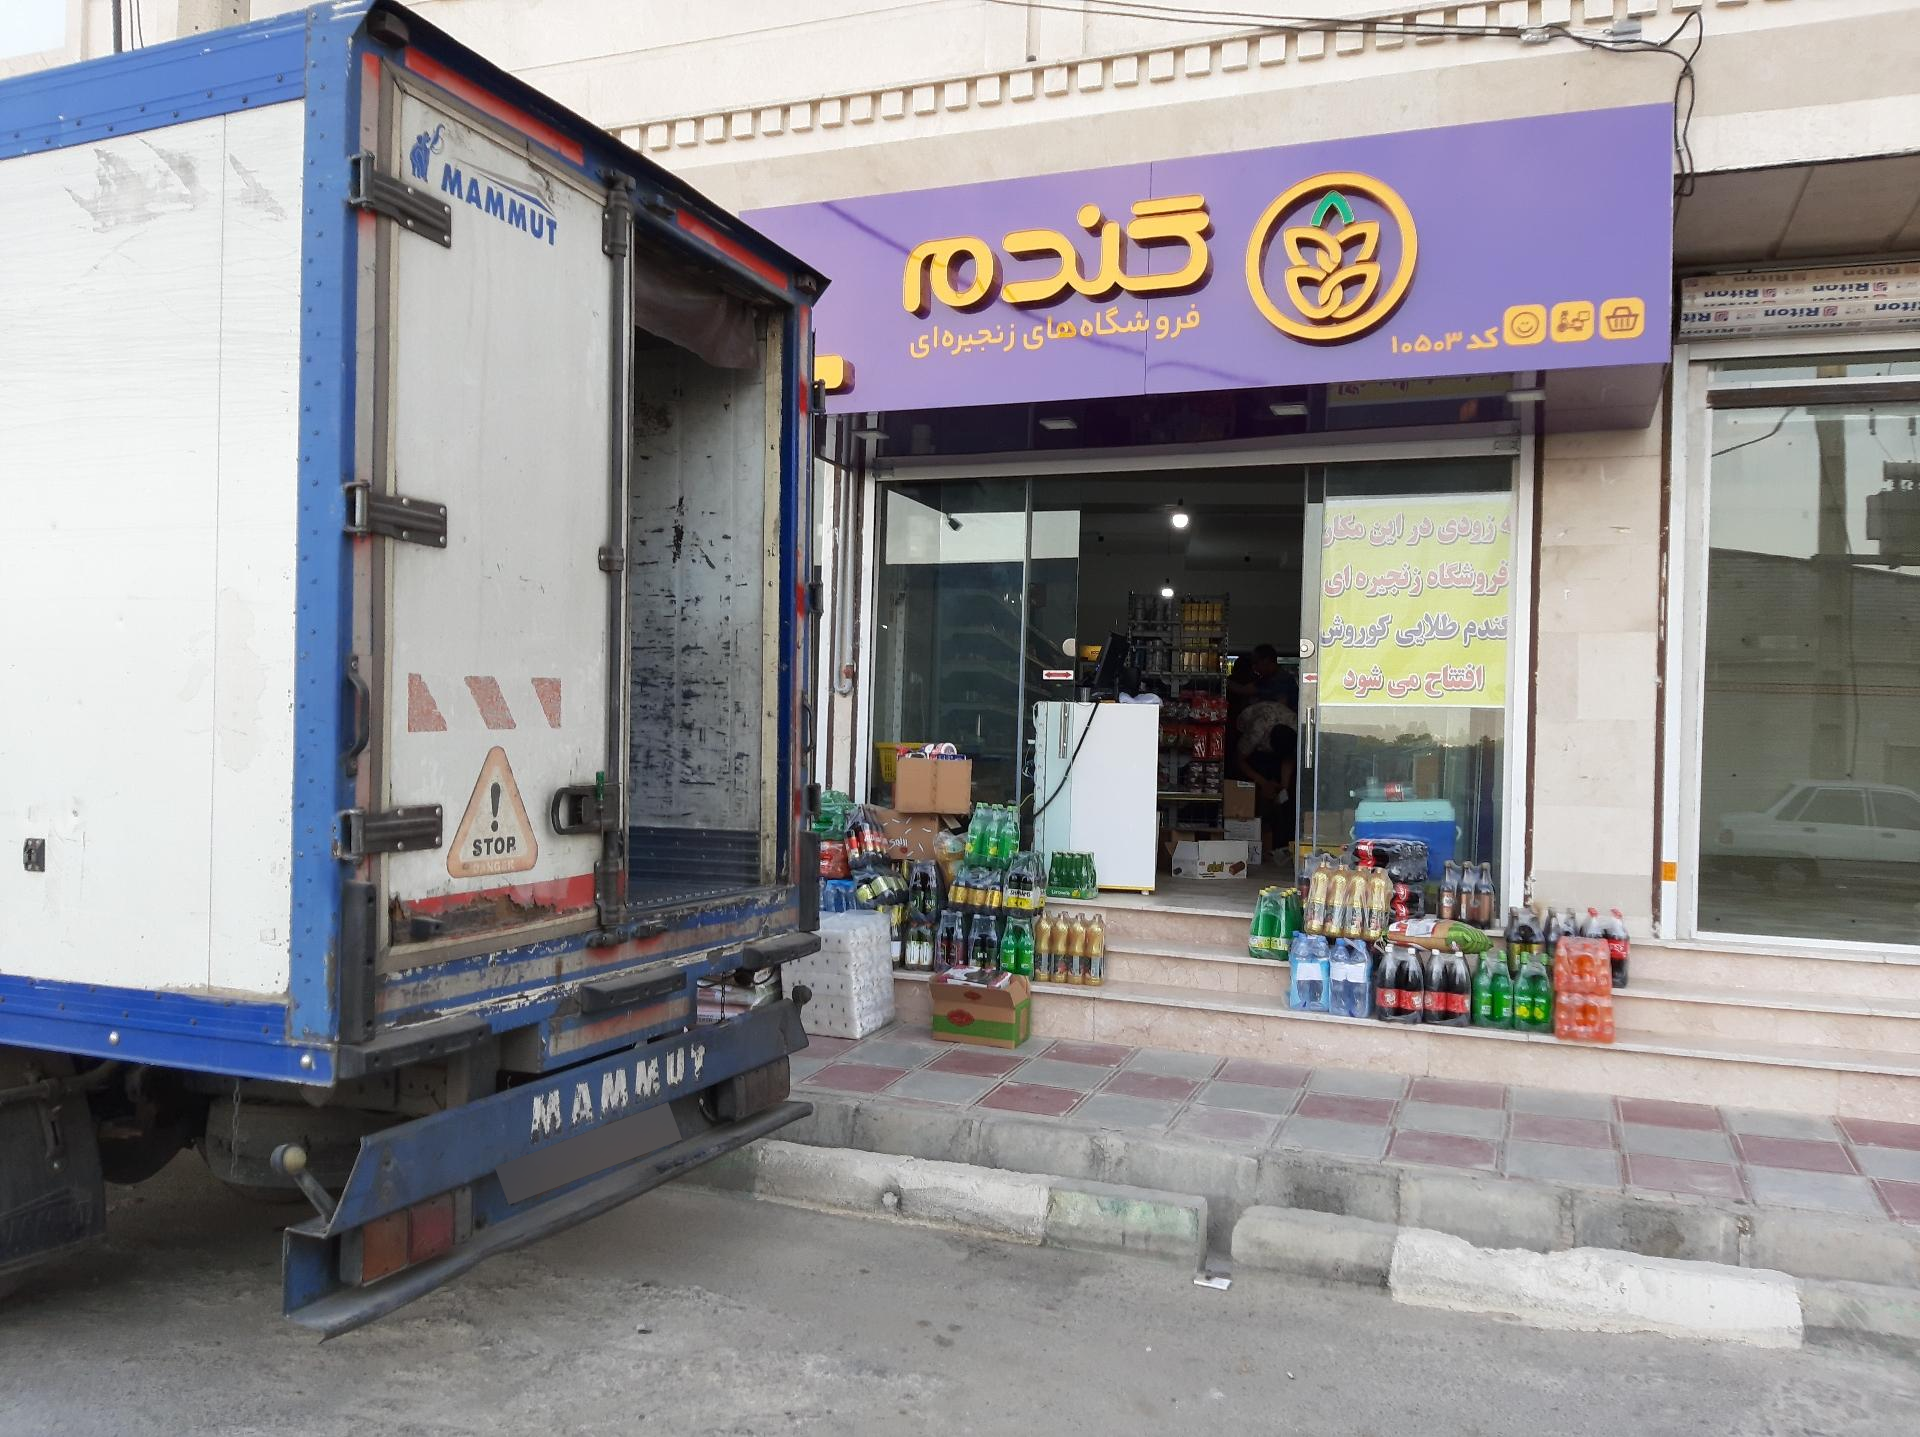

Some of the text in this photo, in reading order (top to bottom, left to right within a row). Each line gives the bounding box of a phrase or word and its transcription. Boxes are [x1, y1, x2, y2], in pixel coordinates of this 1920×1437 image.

[441, 163, 558, 246] MAMMUT
[902, 193, 1211, 315] گندم
[1703, 288, 1759, 298] Riton
[1812, 282, 1869, 292] Riton
[1764, 306, 1820, 317] Riton
[1874, 301, 1920, 312] iton
[1392, 327, 1499, 354] کد ۱۰۵۰۳
[1370, 512, 1404, 546] این
[1407, 516, 1434, 546] در
[1437, 513, 1496, 545] زودی
[1427, 560, 1509, 595] فروشگاه
[1320, 613, 1393, 648] کوروش
[1395, 612, 1460, 647] طلایی
[1343, 663, 1486, 698] افتتاح می شود
[472, 836, 517, 857] STOP
[530, 1043, 706, 1144] MAMMUT
